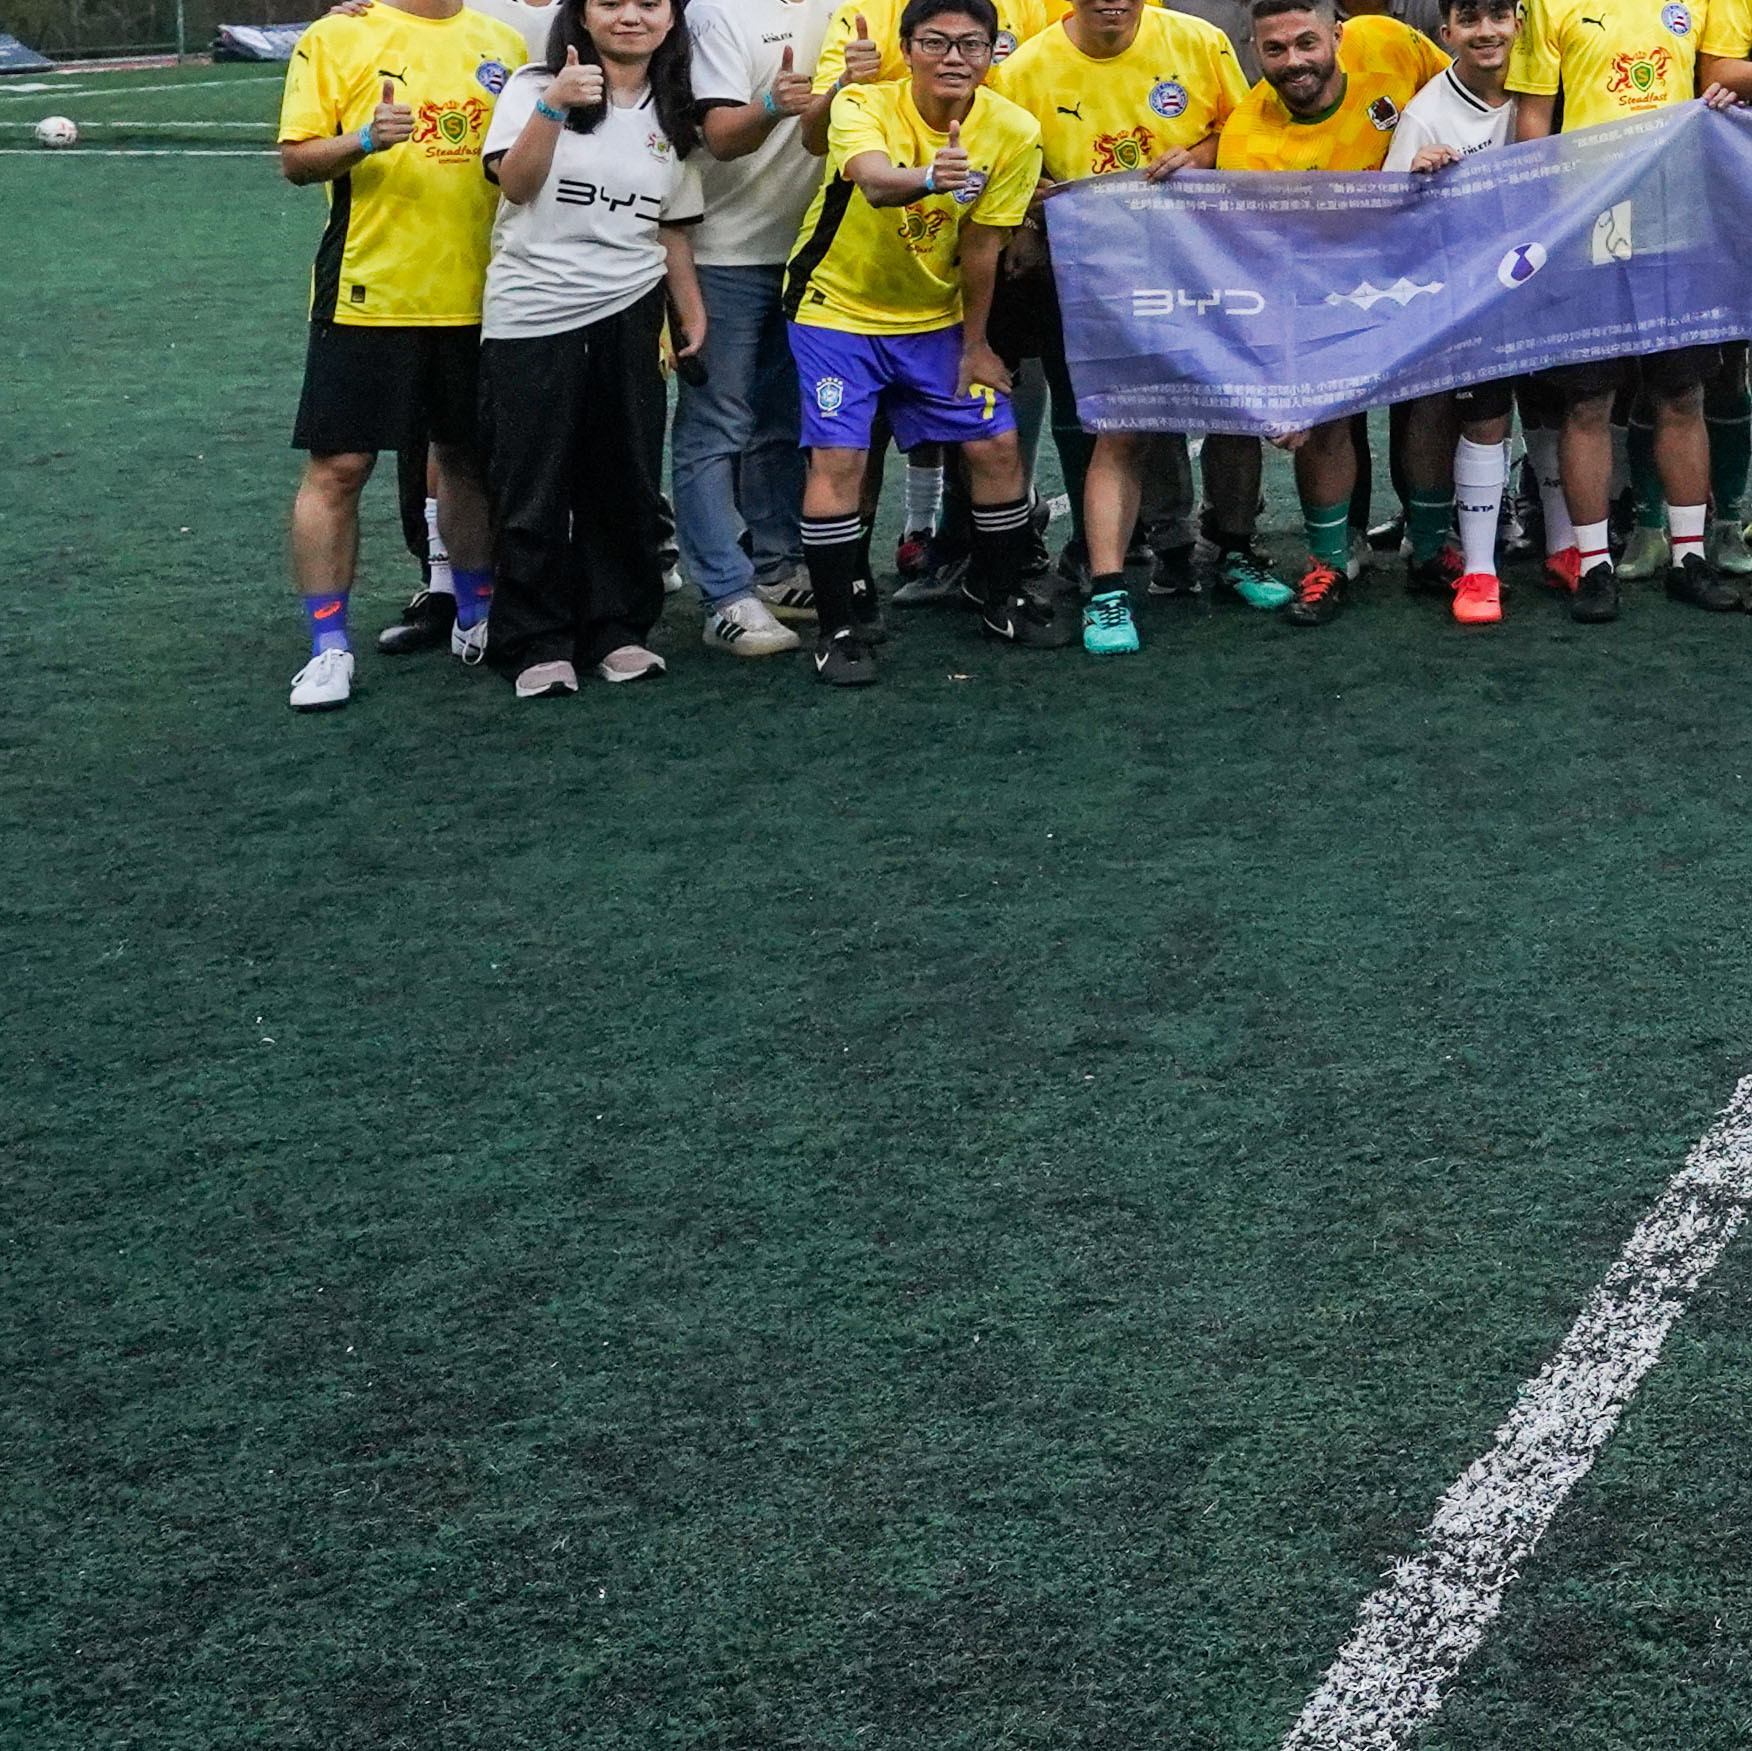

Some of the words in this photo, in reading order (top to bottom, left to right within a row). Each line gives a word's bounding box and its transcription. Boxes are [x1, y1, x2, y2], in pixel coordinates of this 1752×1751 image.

[1619, 92, 1668, 106] Steadfast
[1132, 289, 1266, 316] BYD
[969, 383, 996, 420] 7
